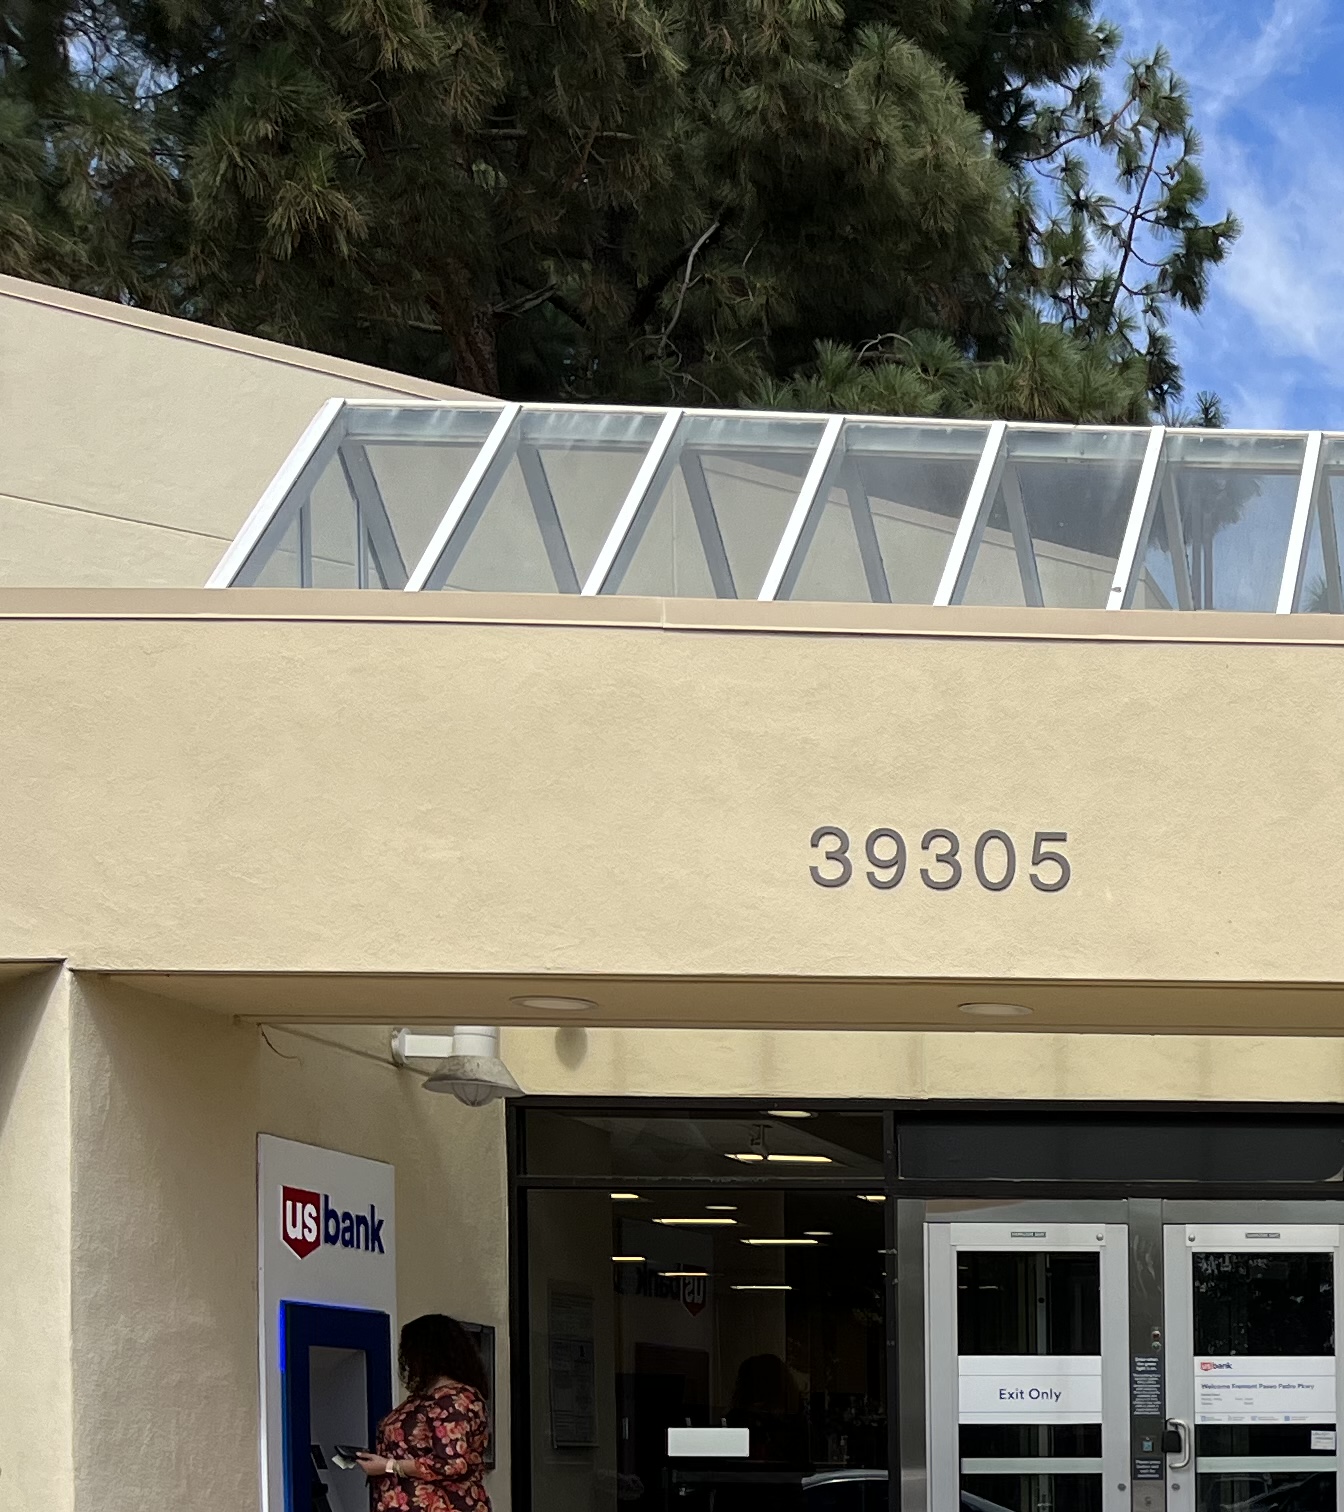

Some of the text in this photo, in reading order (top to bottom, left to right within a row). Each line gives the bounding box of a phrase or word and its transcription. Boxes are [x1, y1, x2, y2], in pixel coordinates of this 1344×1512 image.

[808, 825, 1072, 892] 39305
[286, 1193, 386, 1254] us bank
[1213, 1362, 1233, 1370] bank
[999, 1388, 1062, 1402] Exit Only
